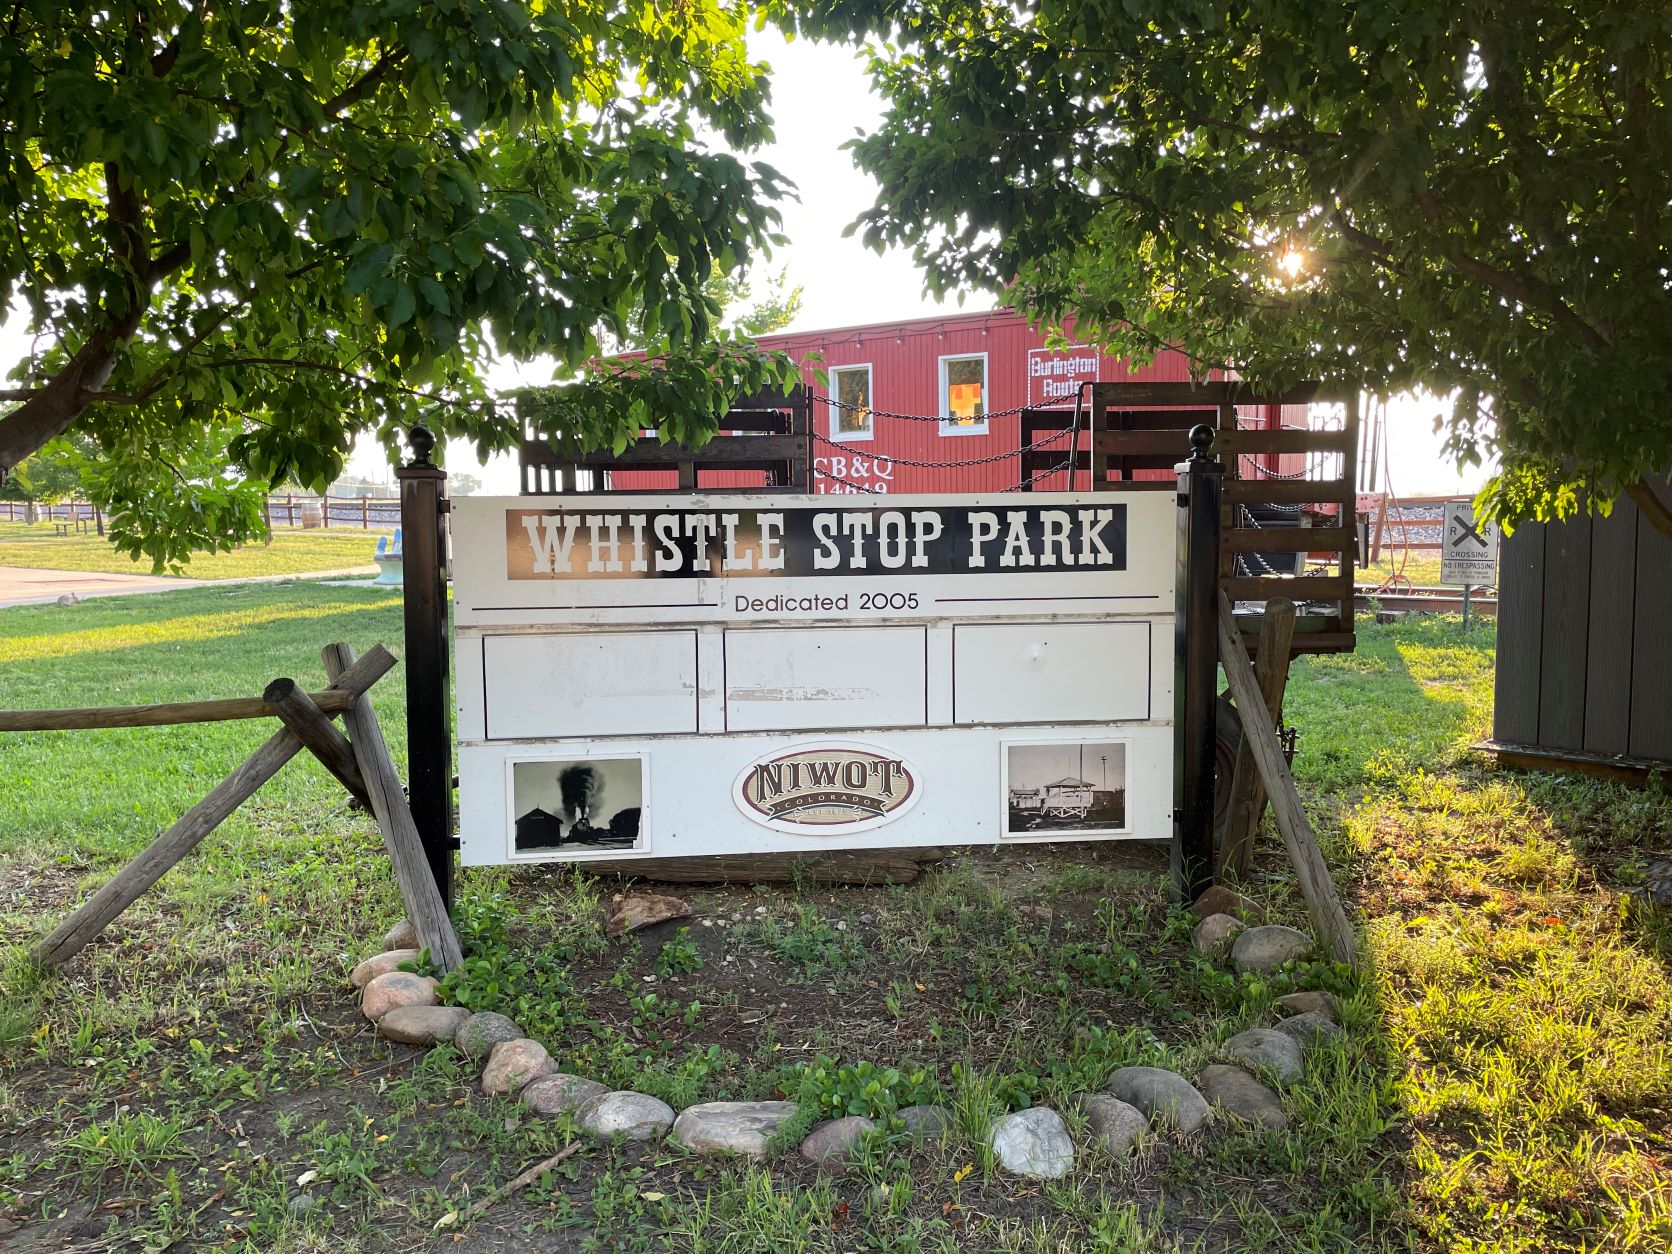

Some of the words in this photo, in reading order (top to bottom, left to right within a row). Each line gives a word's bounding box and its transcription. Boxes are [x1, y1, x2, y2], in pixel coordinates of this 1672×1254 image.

[1031, 356, 1096, 377] Burlington
[814, 455, 894, 480] CB&Q
[521, 513, 785, 573] WHISTLE
[812, 511, 944, 569] STOP
[968, 509, 1113, 568] PARK
[1454, 562, 1495, 570] TRESPASSING
[735, 594, 848, 613] Dedicated
[859, 593, 919, 610] 2005
[754, 760, 904, 804] NIWOT
[785, 794, 871, 808] COLORADO
